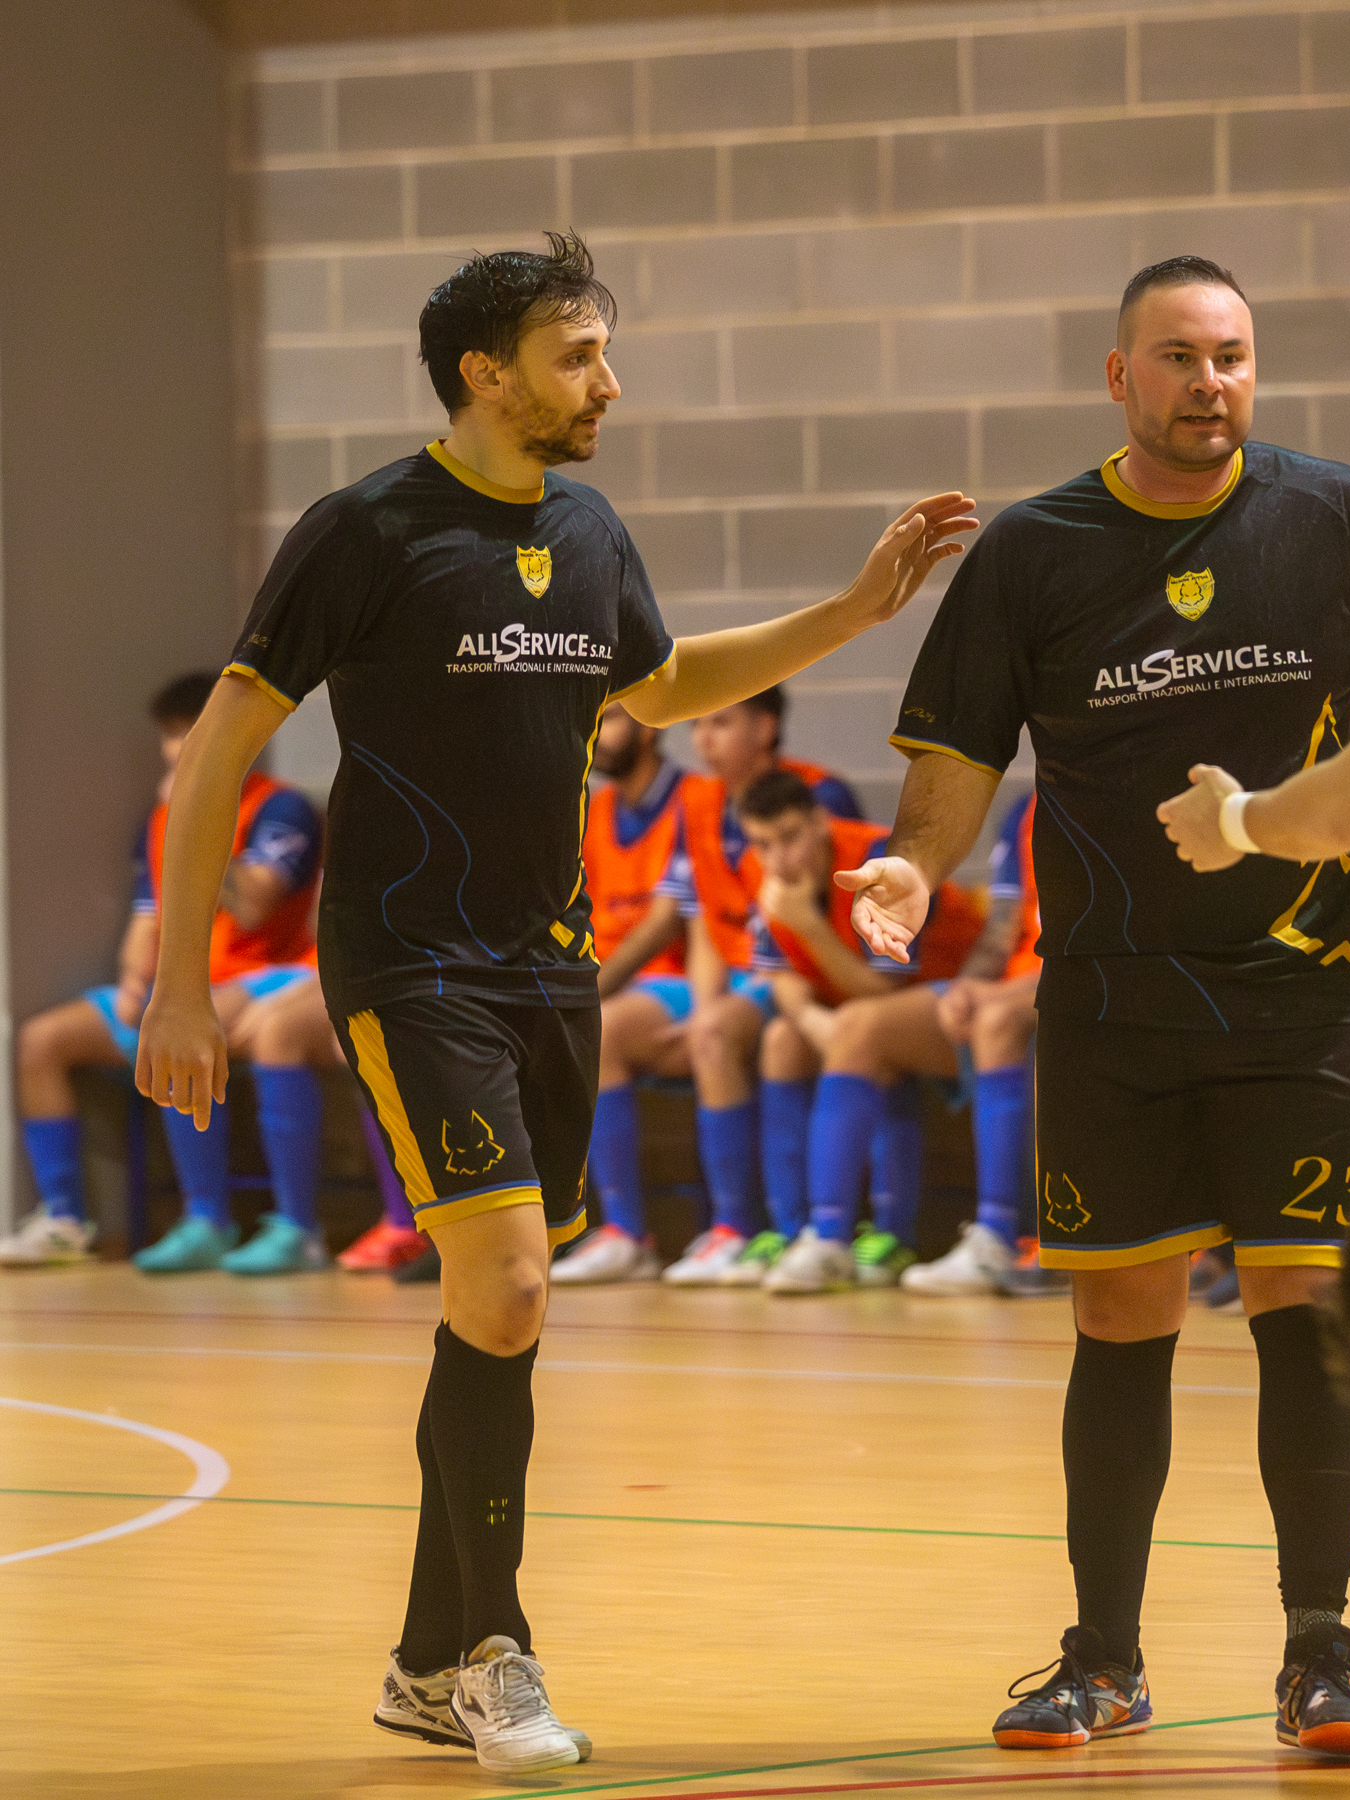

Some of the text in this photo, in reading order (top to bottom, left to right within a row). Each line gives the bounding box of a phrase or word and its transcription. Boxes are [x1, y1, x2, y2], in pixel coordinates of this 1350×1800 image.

[1272, 650, 1313, 666] S.R.L.
[446, 662, 501, 674] TRASPORTI
[503, 662, 545, 673] NAZIONALI
[1087, 669, 1311, 709] TRASPORTI NAZIONALI E INTERNAZIONALI
